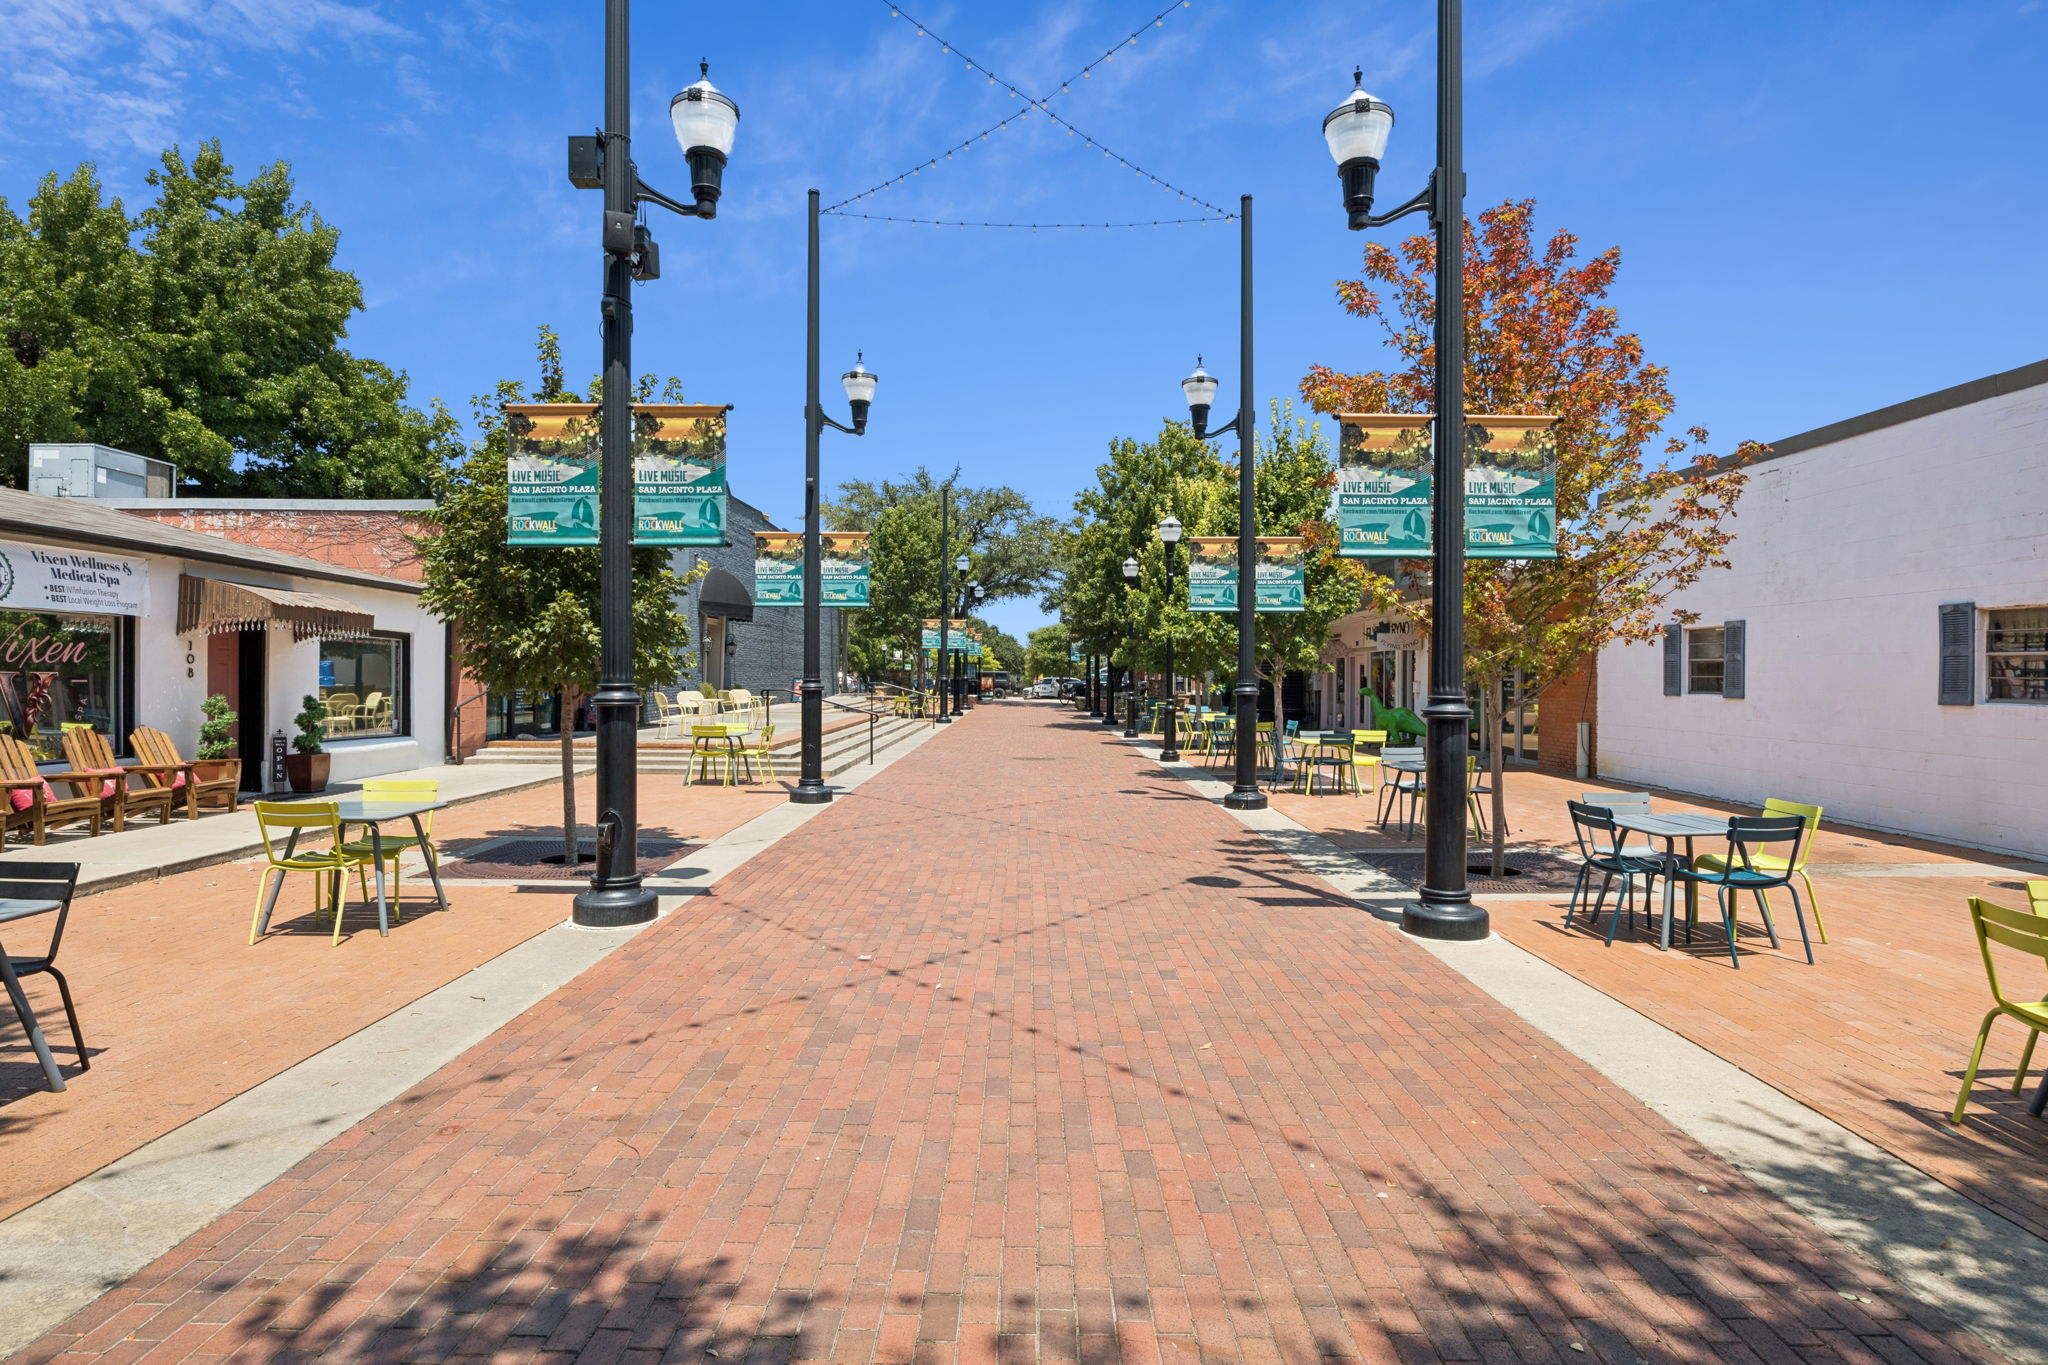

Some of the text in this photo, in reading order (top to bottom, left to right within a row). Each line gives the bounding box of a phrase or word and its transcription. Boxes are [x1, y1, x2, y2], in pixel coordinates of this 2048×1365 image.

[512, 470, 561, 482] LIVE MUSIC
[639, 470, 688, 482] LIVE MUSIC
[511, 485, 596, 494] SAN JACINTO PLAZA
[638, 485, 723, 494] SAN JACINTO PLAZA
[1343, 481, 1392, 493] LIVE MUSIC
[1468, 482, 1516, 494] LIVE MUSIC
[1342, 497, 1428, 505] SAN JACINTO PLAZA
[1487, 498, 1523, 506] JACINTO
[1524, 498, 1553, 506] PLAZA
[512, 520, 558, 531] ROCKWALL
[638, 520, 684, 531] ROCKWALL
[1343, 531, 1389, 542] ROCKWALL
[1469, 532, 1514, 542] ROCKWALL
[31, 550, 133, 577] Vixen Wellness &
[50, 567, 121, 588] Medical Spa
[49, 584, 66, 593] BEST
[97, 588, 119, 599] Therapy
[51, 595, 139, 610] BEST Local Weight Loss Program
[1391, 621, 1410, 634] RYNO
[0, 617, 88, 668] ixen
[1380, 639, 1401, 649] FLYING
[186, 640, 195, 678] 108
[74, 698, 88, 720] SPA
